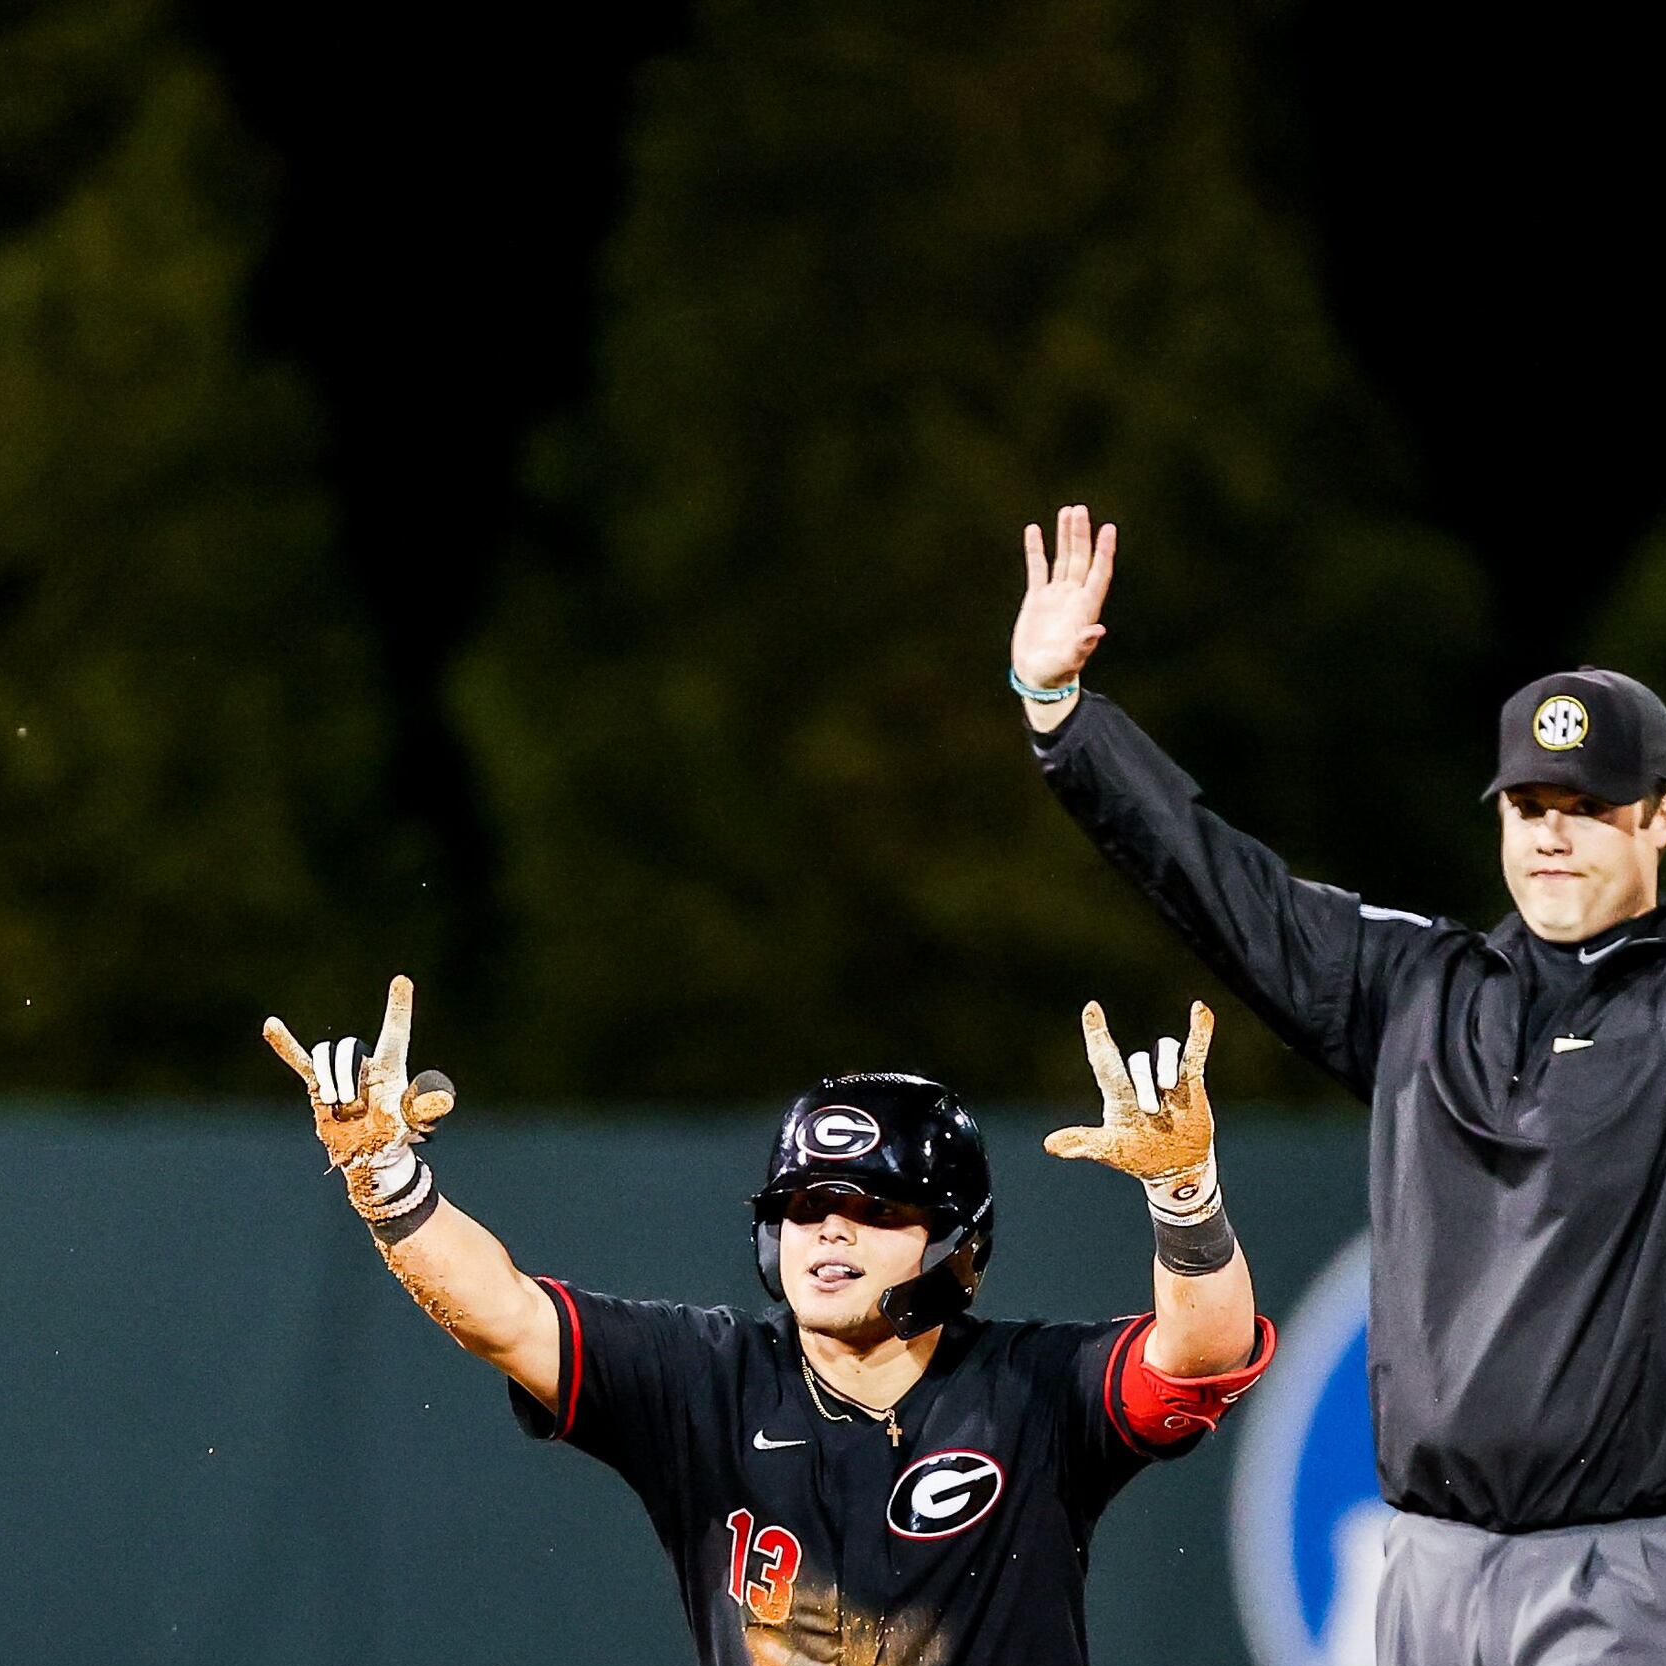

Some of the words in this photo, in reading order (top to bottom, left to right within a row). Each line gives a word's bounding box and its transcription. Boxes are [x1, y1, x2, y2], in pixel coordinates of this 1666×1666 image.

[1537, 699, 1585, 747] SEC
[807, 1110, 879, 1153] G
[900, 1455, 1001, 1529] G
[726, 1507, 802, 1624] 13
